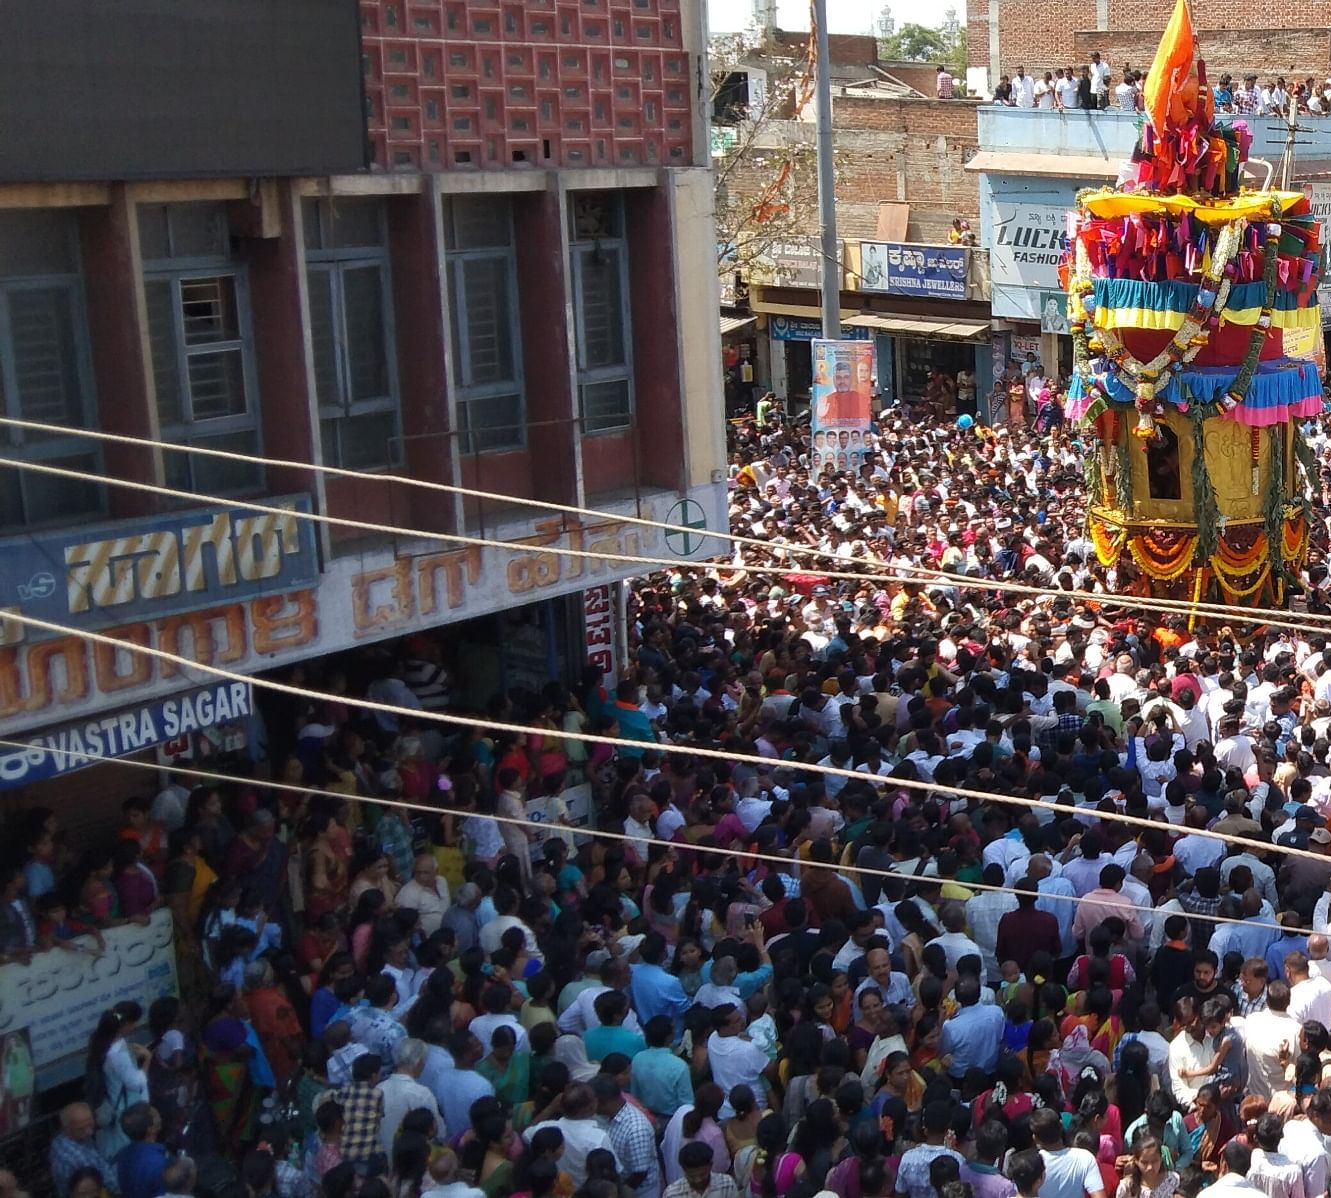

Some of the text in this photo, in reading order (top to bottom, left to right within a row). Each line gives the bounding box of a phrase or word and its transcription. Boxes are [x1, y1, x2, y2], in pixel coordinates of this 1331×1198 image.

[1311, 203, 1331, 215] UCKY
[997, 225, 1068, 250] LUCK
[922, 279, 965, 292] JEWELLERS
[47, 707, 160, 772] VASTRA
[162, 682, 250, 737] SAGAR
